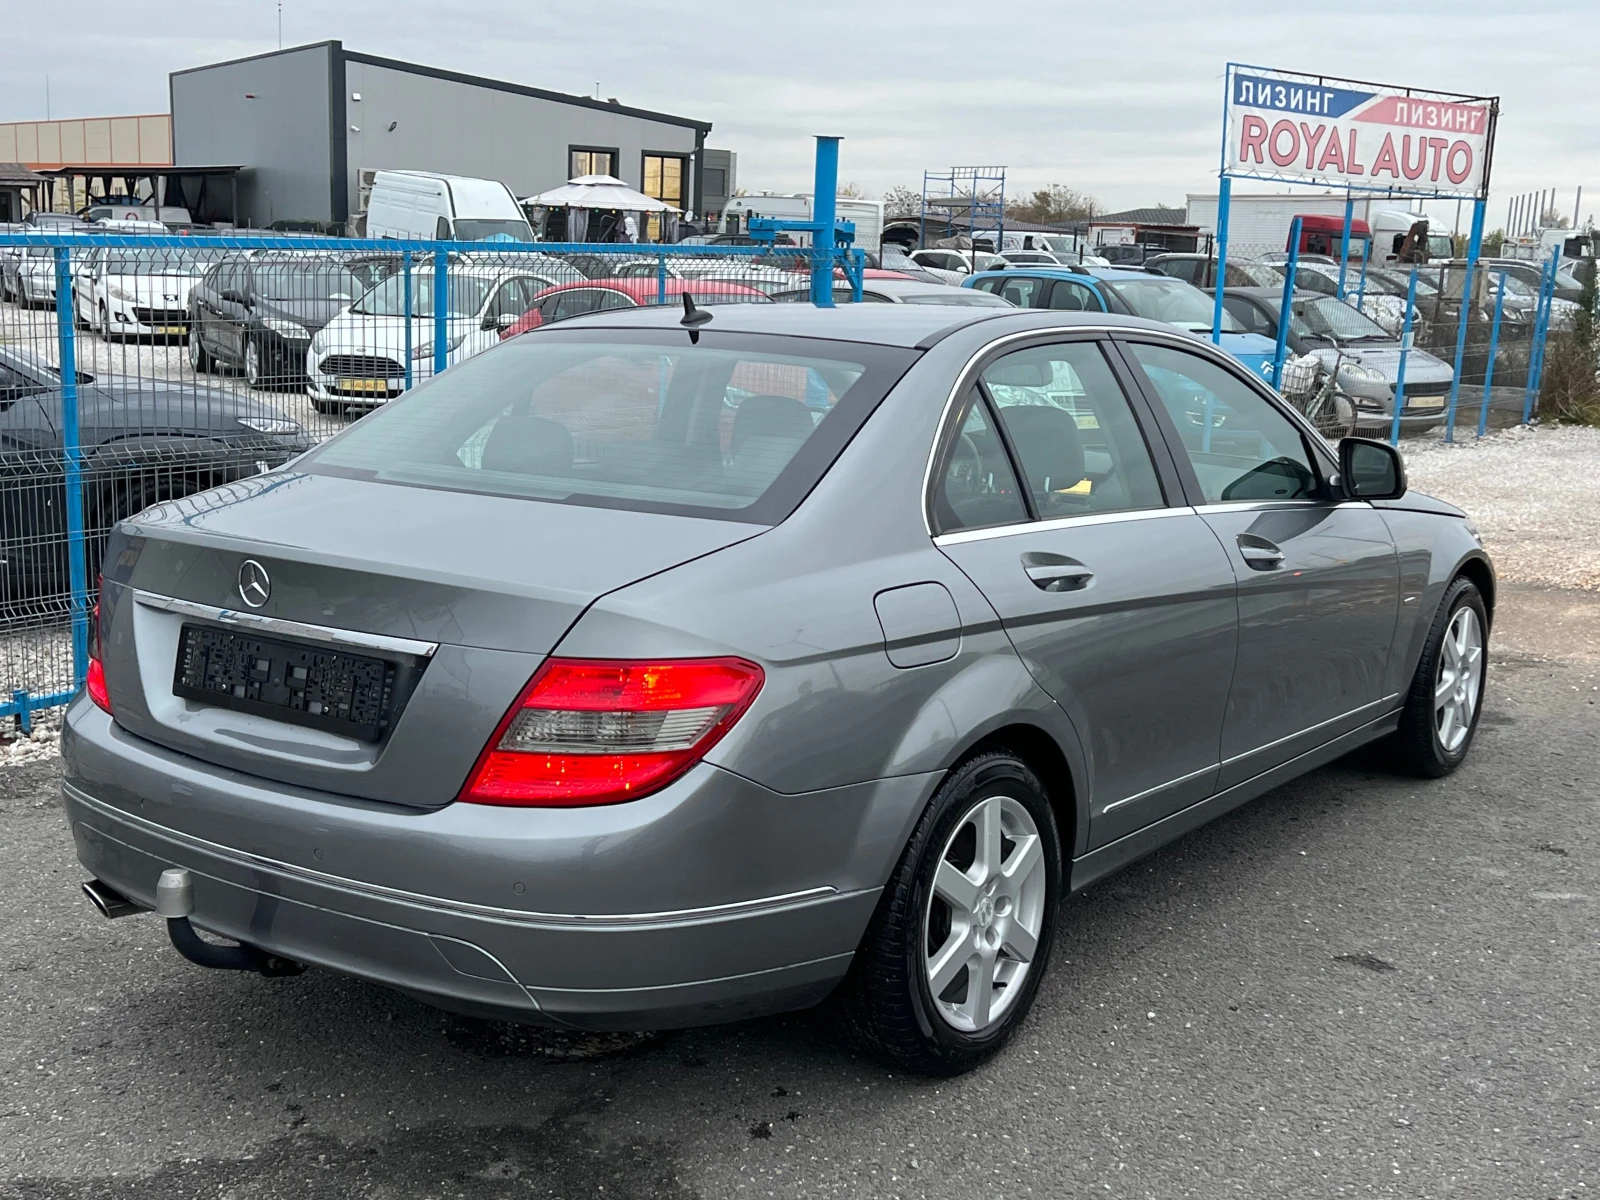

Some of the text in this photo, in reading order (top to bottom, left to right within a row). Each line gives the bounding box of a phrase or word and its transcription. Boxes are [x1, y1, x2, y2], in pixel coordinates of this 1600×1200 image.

[1239, 80, 1334, 113] ЛИЗИНГ
[1394, 102, 1481, 131] ЛИЗИНГ
[1240, 115, 1472, 184] ROYAL AUTO
